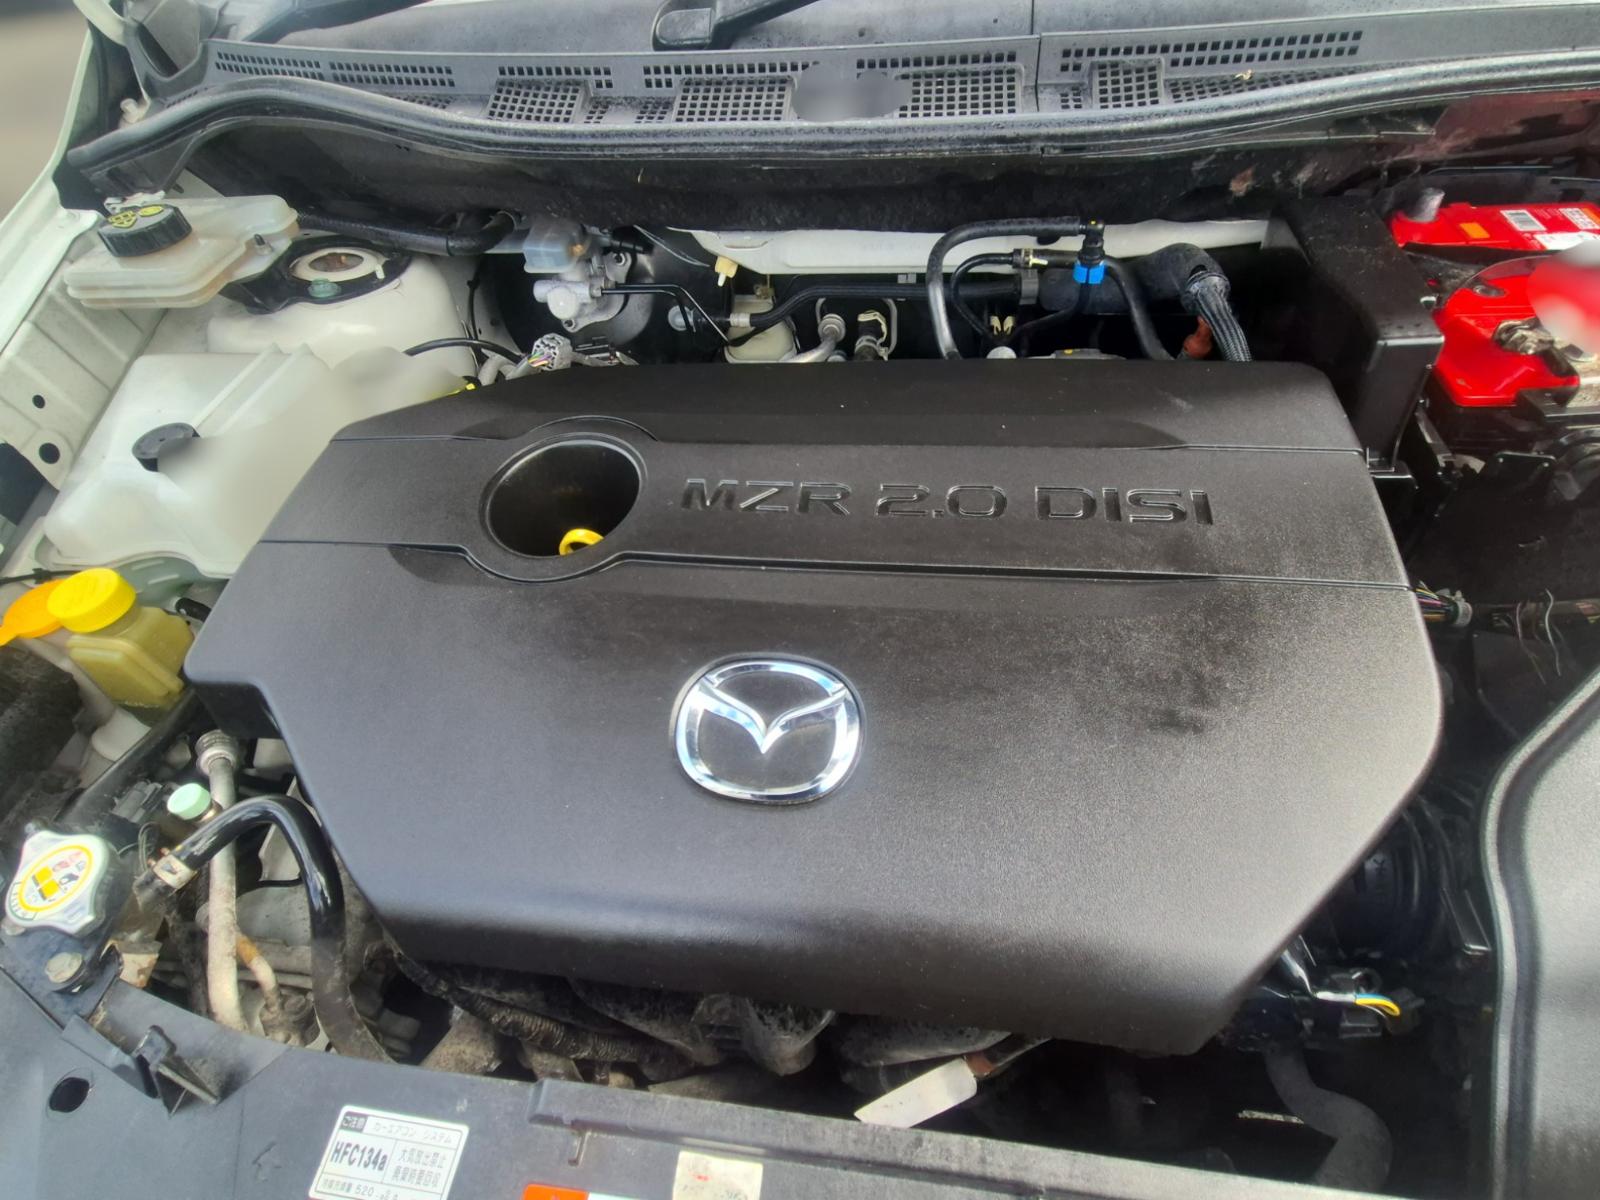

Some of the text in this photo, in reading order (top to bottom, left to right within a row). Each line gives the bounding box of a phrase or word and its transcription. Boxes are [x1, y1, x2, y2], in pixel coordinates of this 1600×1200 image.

[681, 477, 1214, 526] MZR 2.0 DISI
[330, 1141, 388, 1172] HFC134a
